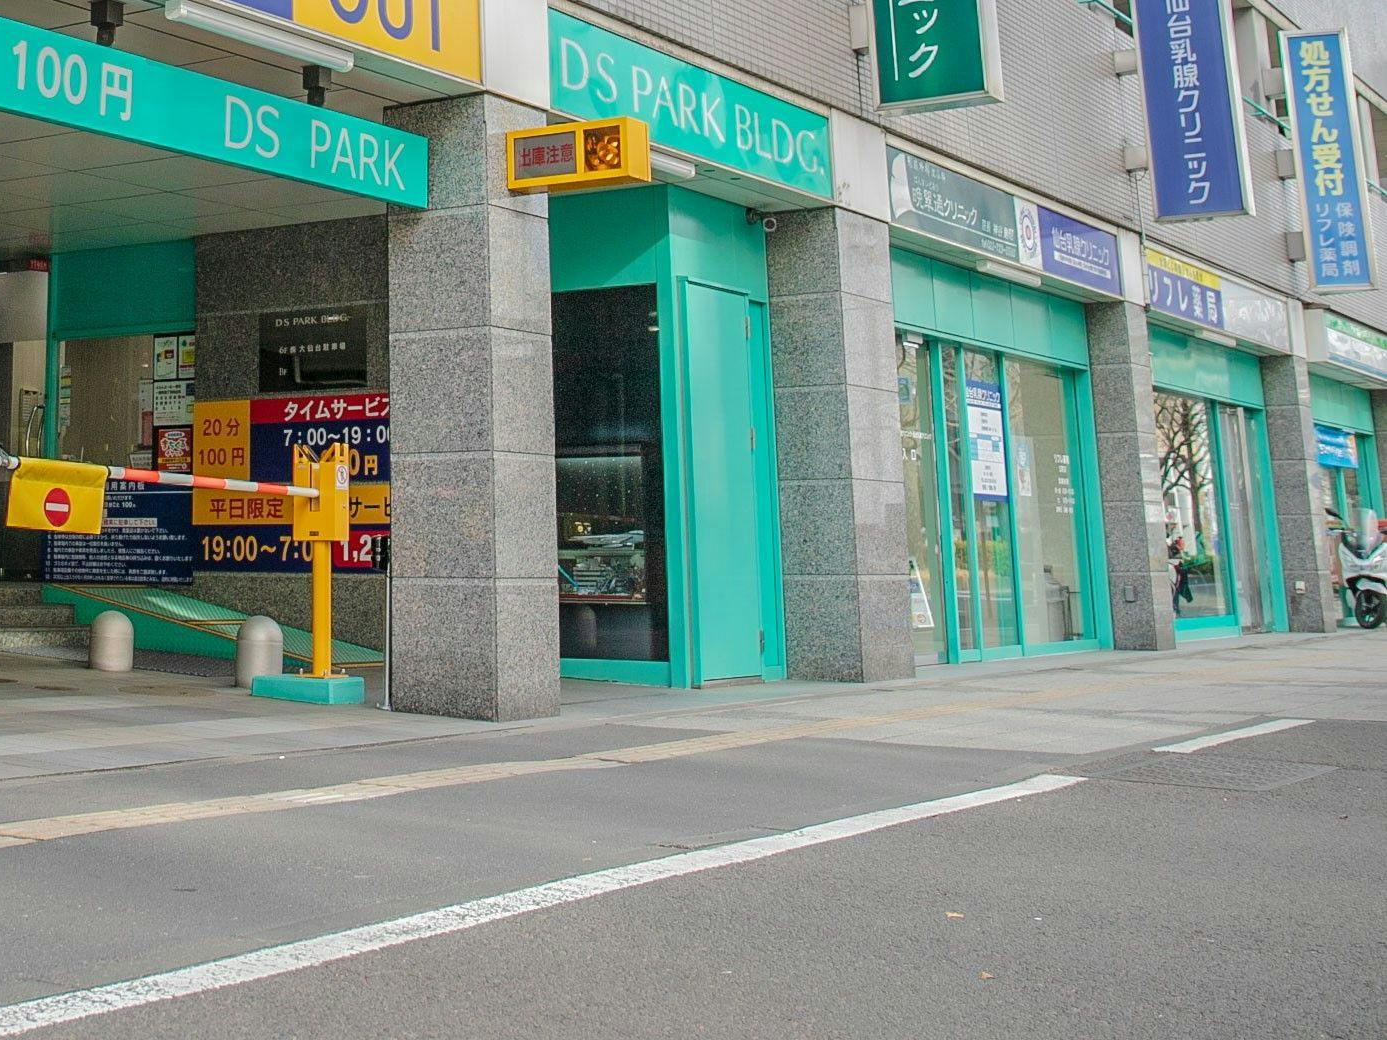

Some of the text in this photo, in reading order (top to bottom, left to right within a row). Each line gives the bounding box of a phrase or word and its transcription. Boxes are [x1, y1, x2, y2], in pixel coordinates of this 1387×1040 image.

[559, 37, 618, 103] DS
[631, 66, 726, 143] PARK
[1300, 40, 1344, 197] 処方せん受付
[224, 94, 405, 191] DS PARK
[519, 143, 575, 168] 出庫注意
[1315, 203, 1339, 278] リフレ薬局
[1335, 202, 1361, 277] 保険調剤
[293, 316, 317, 326] PARK
[209, 497, 283, 519] 平日限定
